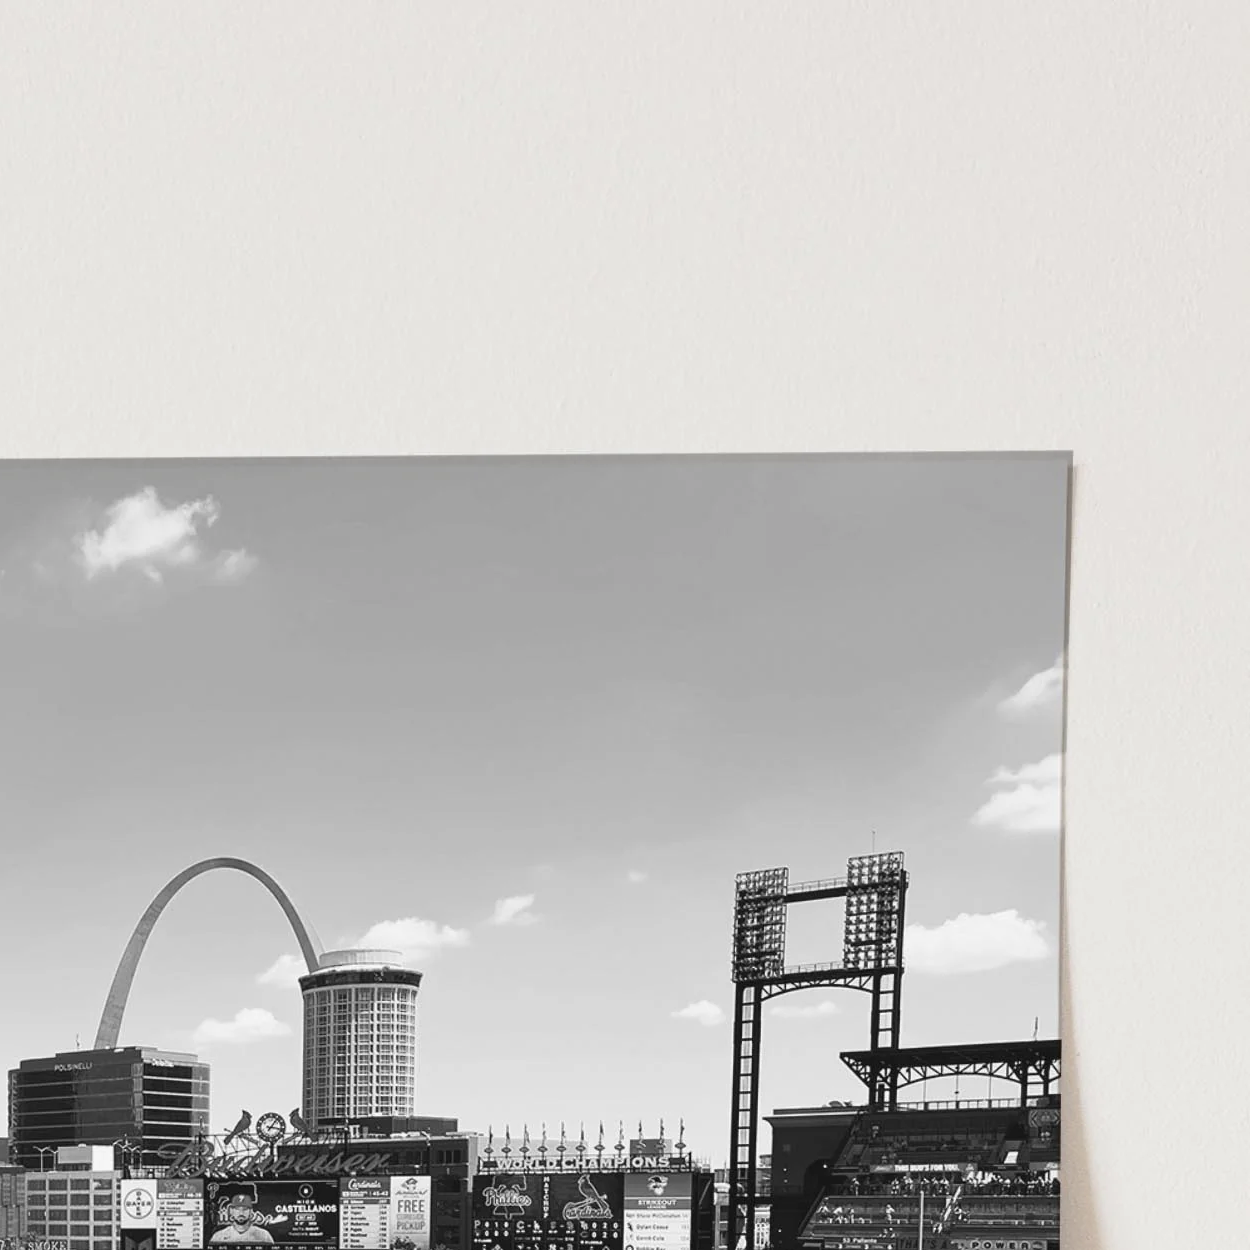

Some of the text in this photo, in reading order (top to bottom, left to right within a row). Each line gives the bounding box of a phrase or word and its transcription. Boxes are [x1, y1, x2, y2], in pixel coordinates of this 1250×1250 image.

[497, 1156, 670, 1168] WORLD CHAMPIONS
[275, 1204, 338, 1213] CASTELLANOS
[397, 1199, 425, 1213] FREE
[396, 1221, 426, 1231] PICKUP
[971, 1240, 1030, 1250] POWER
